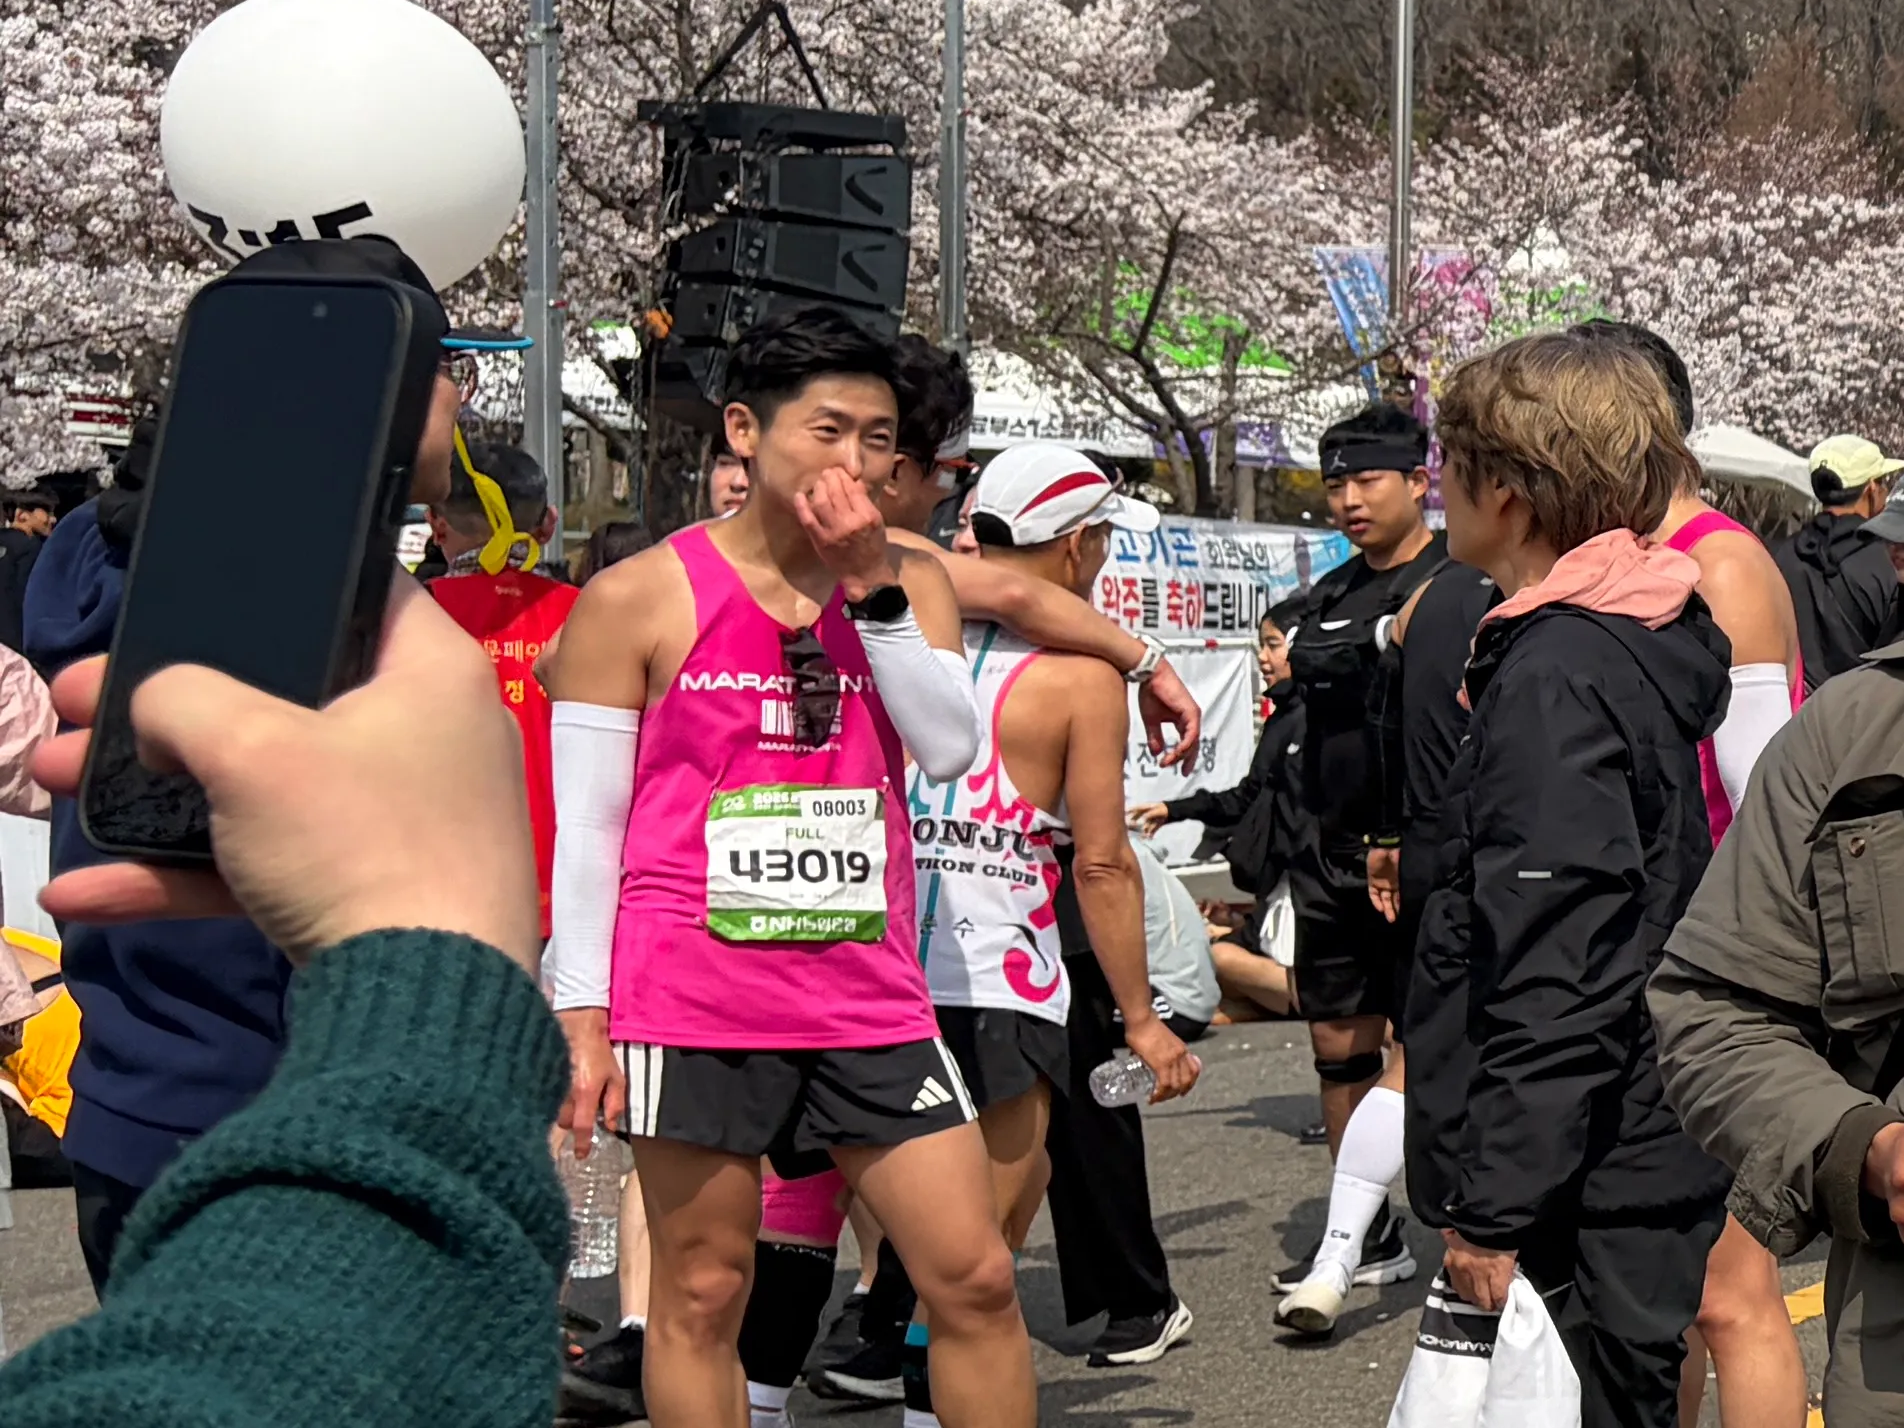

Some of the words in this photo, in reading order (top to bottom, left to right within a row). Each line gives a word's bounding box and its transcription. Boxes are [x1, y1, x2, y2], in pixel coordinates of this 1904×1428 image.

[1116, 526, 1199, 569] 고기곤
[1206, 537, 1270, 571] 회원님의
[1167, 578, 1270, 632] 축하드립니다
[812, 799, 867, 817] 08003
[785, 827, 826, 840] FULL
[912, 817, 1036, 862] ONJU
[729, 848, 871, 884] 43019
[982, 863, 1038, 887] CLUB
